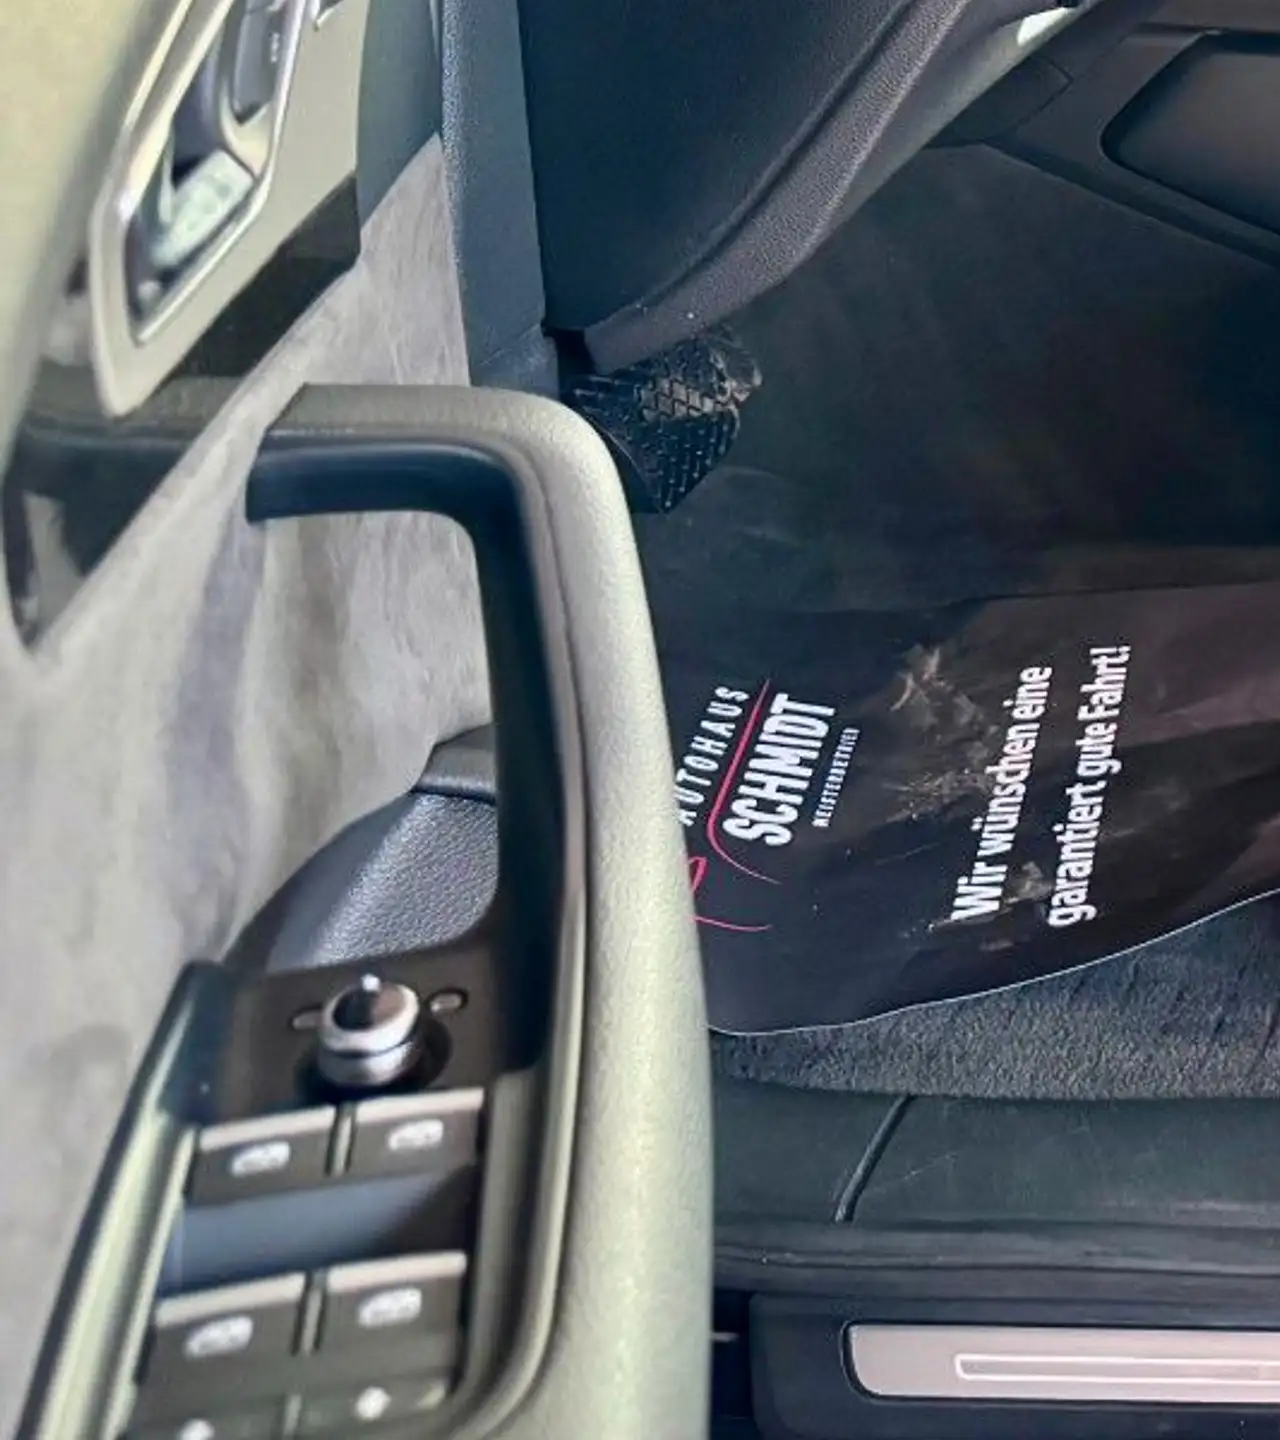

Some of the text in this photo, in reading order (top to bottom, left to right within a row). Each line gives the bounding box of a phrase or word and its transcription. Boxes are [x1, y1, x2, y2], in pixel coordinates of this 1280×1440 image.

[722, 692, 836, 847] SCHMIDT
[951, 665, 1052, 921] Wir wünschen eine
[1047, 645, 1132, 928] garantiert gute Fahrt!
